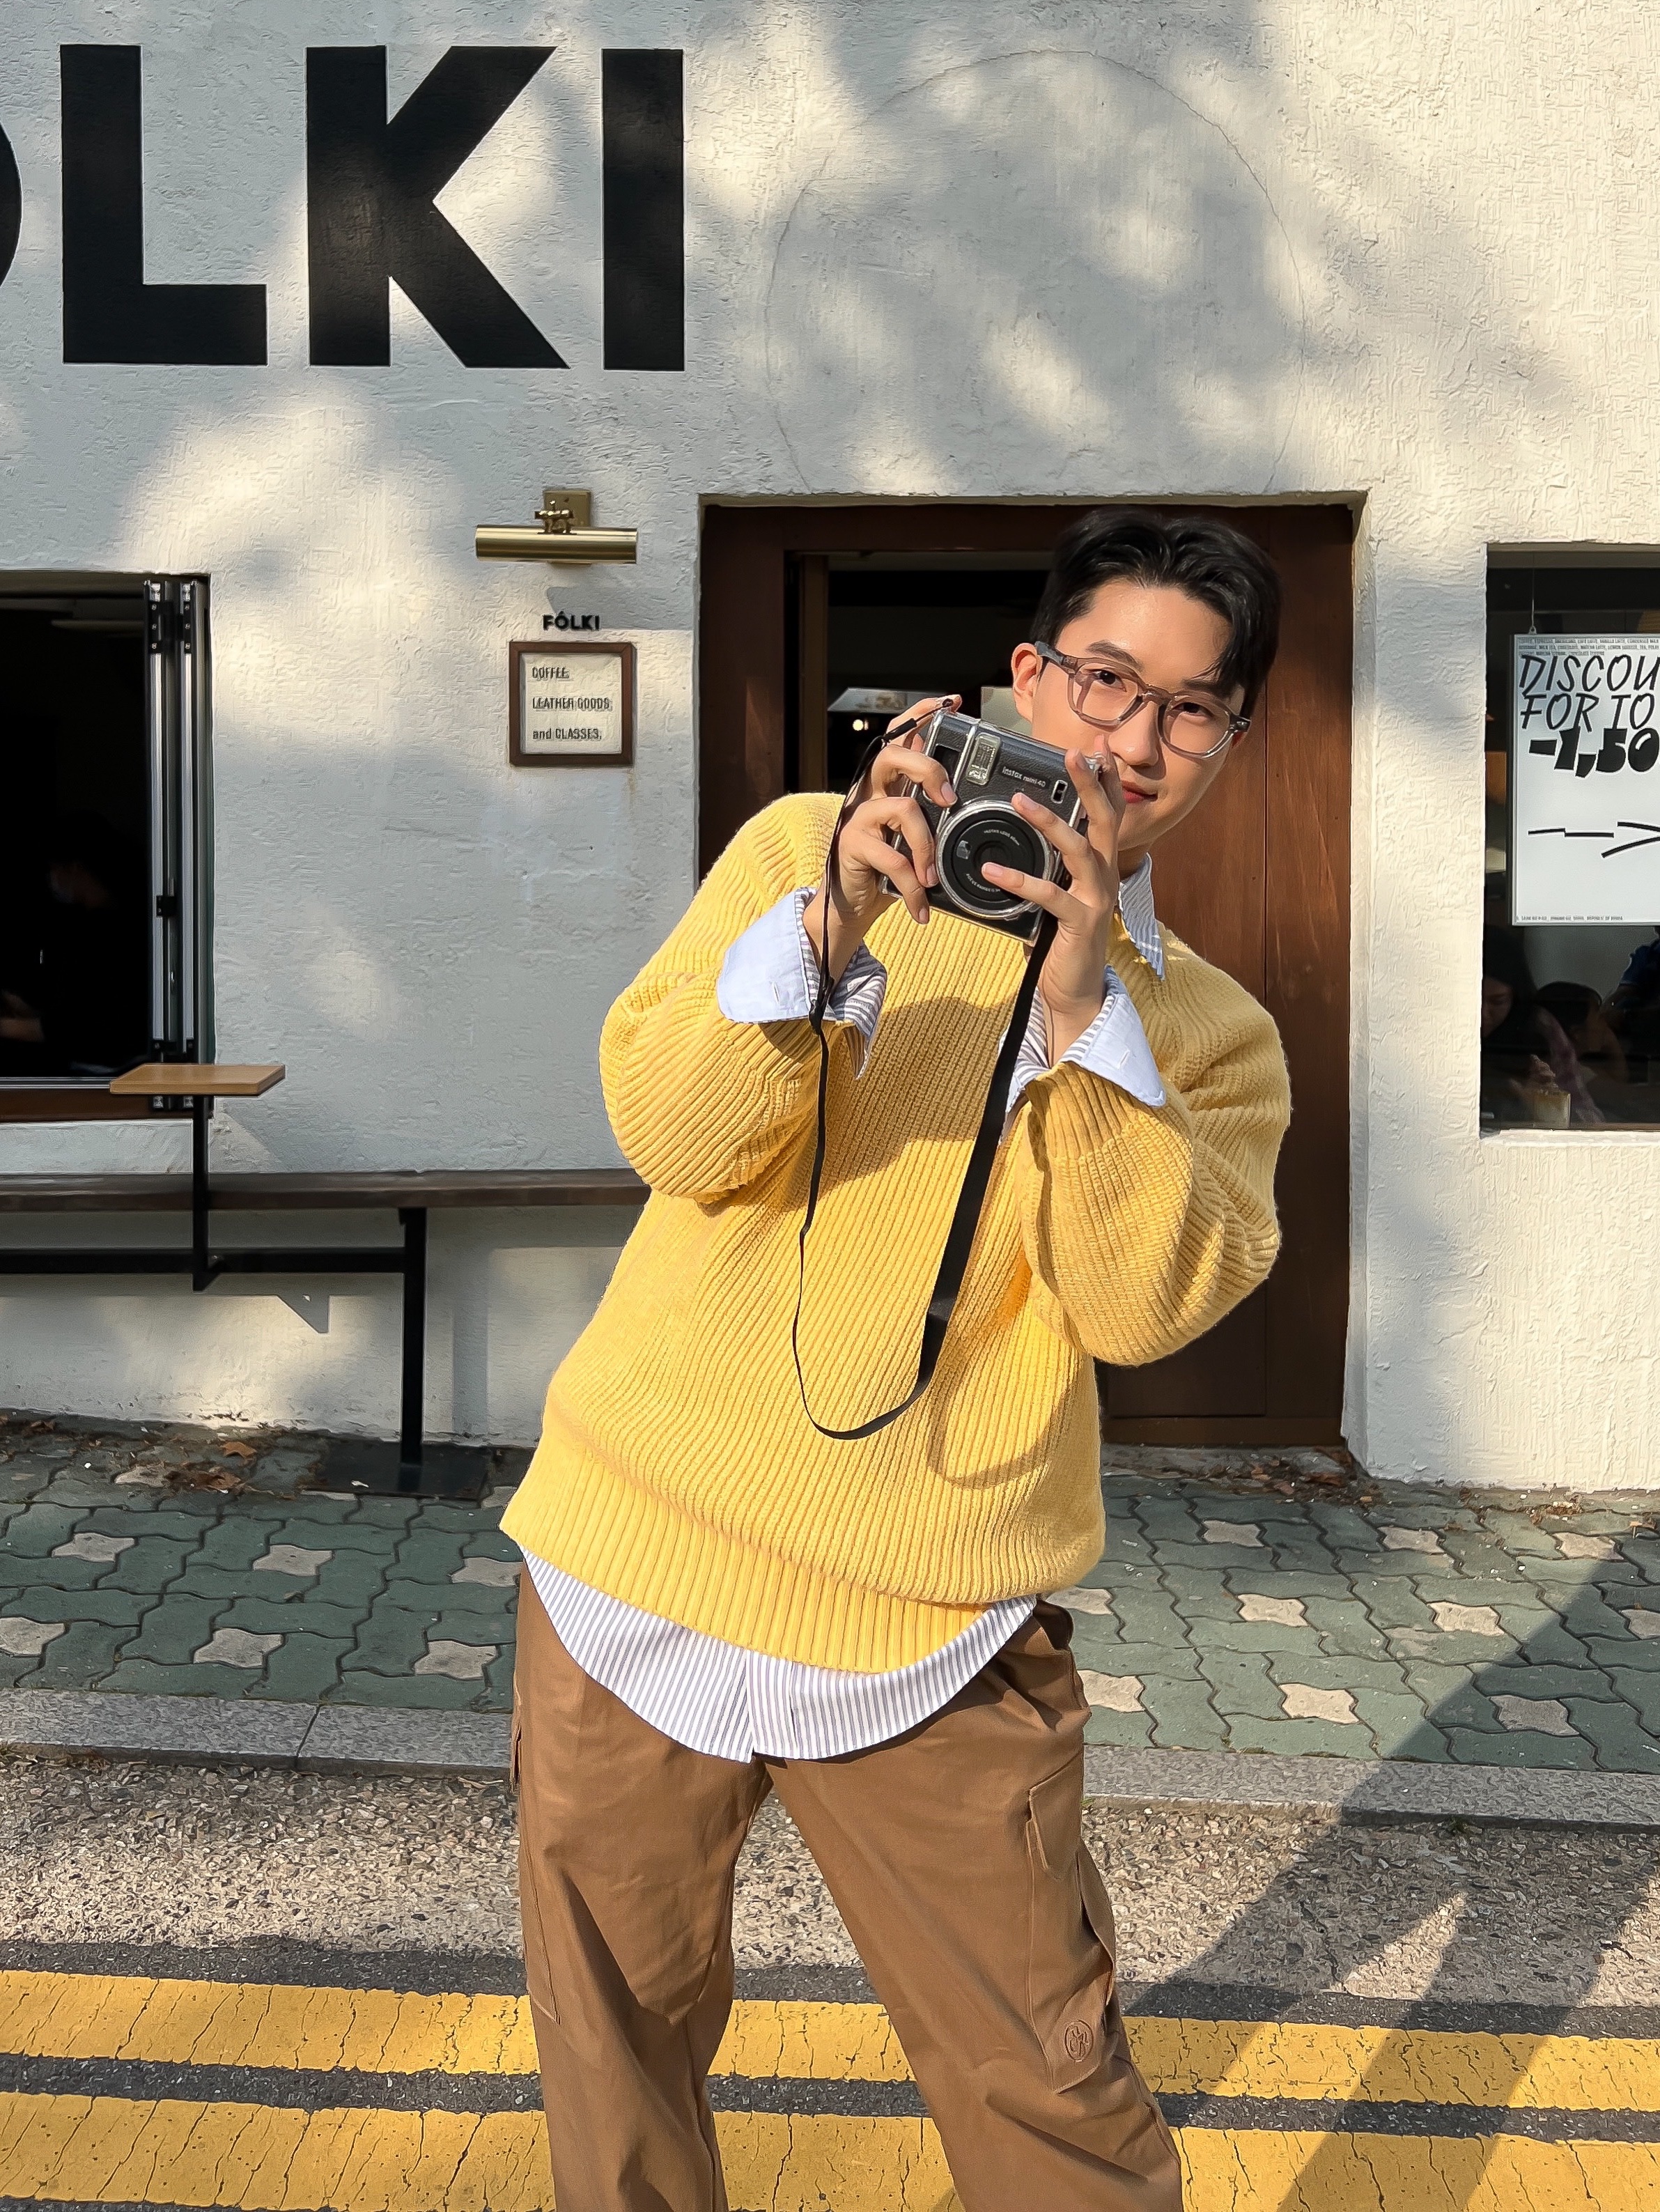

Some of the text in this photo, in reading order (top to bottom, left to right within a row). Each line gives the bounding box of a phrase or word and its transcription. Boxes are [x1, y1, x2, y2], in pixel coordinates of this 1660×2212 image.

[0, 45, 684, 370] LKI
[532, 697, 574, 709] LEATHER
[1520, 693, 1655, 732] FOR TO
[532, 727, 552, 739] and
